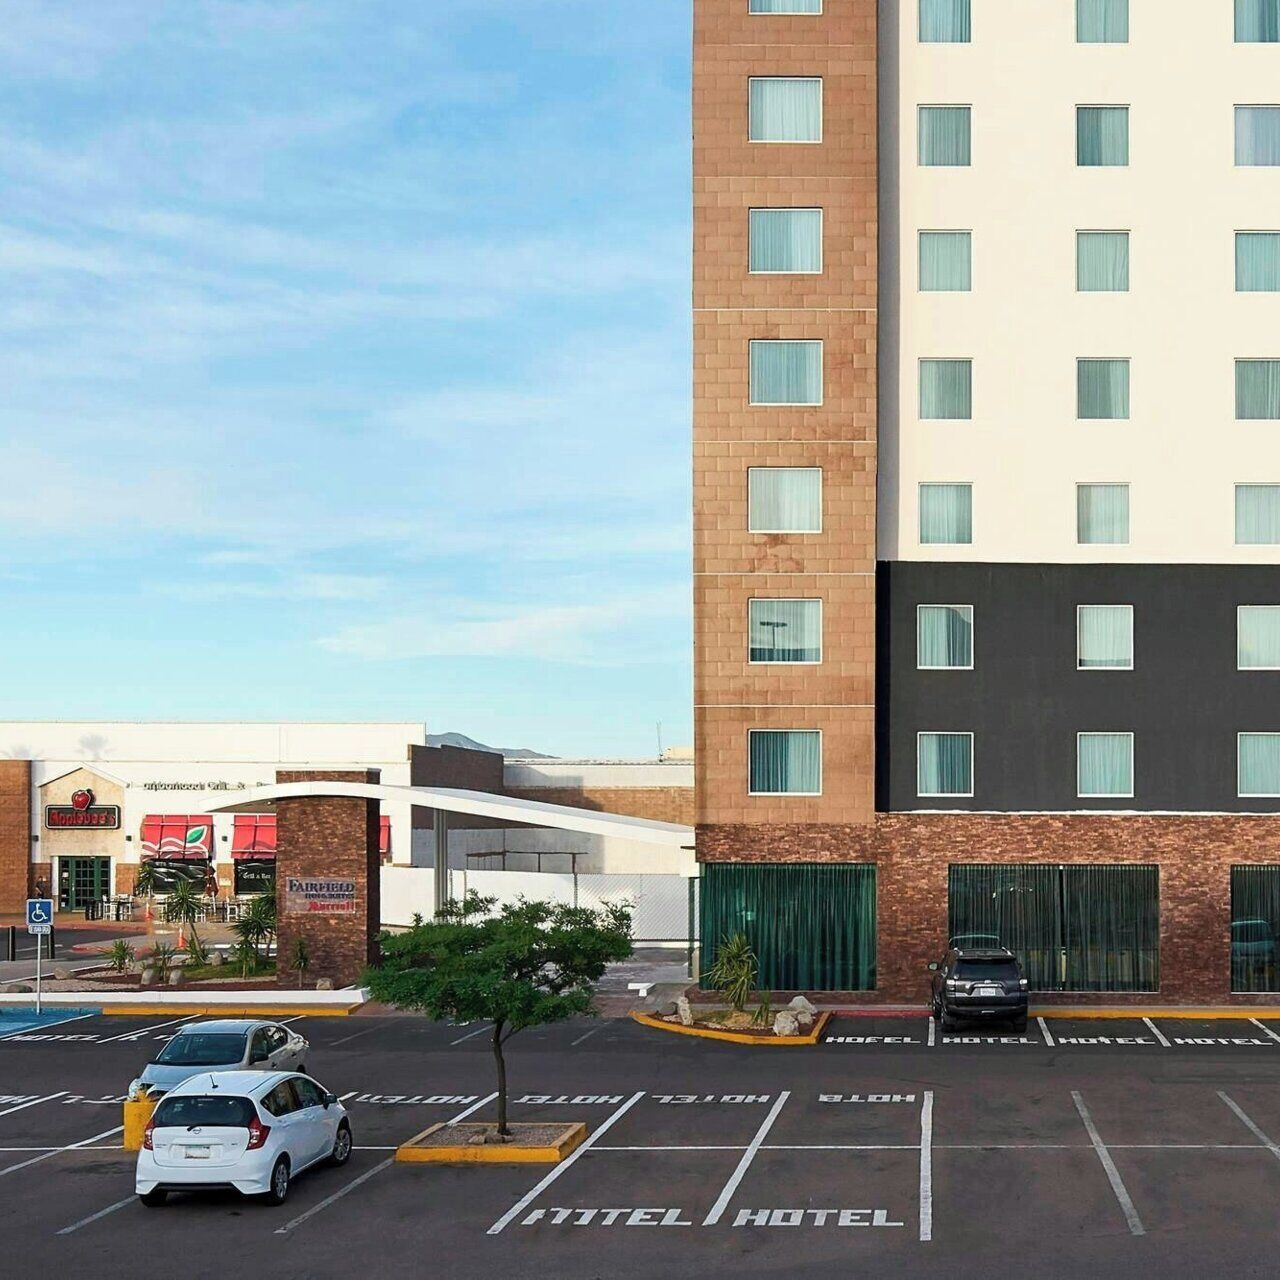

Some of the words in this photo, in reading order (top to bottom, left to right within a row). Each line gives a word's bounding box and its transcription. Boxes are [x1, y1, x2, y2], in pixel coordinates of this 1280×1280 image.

[289, 880, 355, 892] FAIRFIELD
[1174, 1038, 1273, 1046] HOTEL
[731, 1209, 904, 1227] HOTEL
